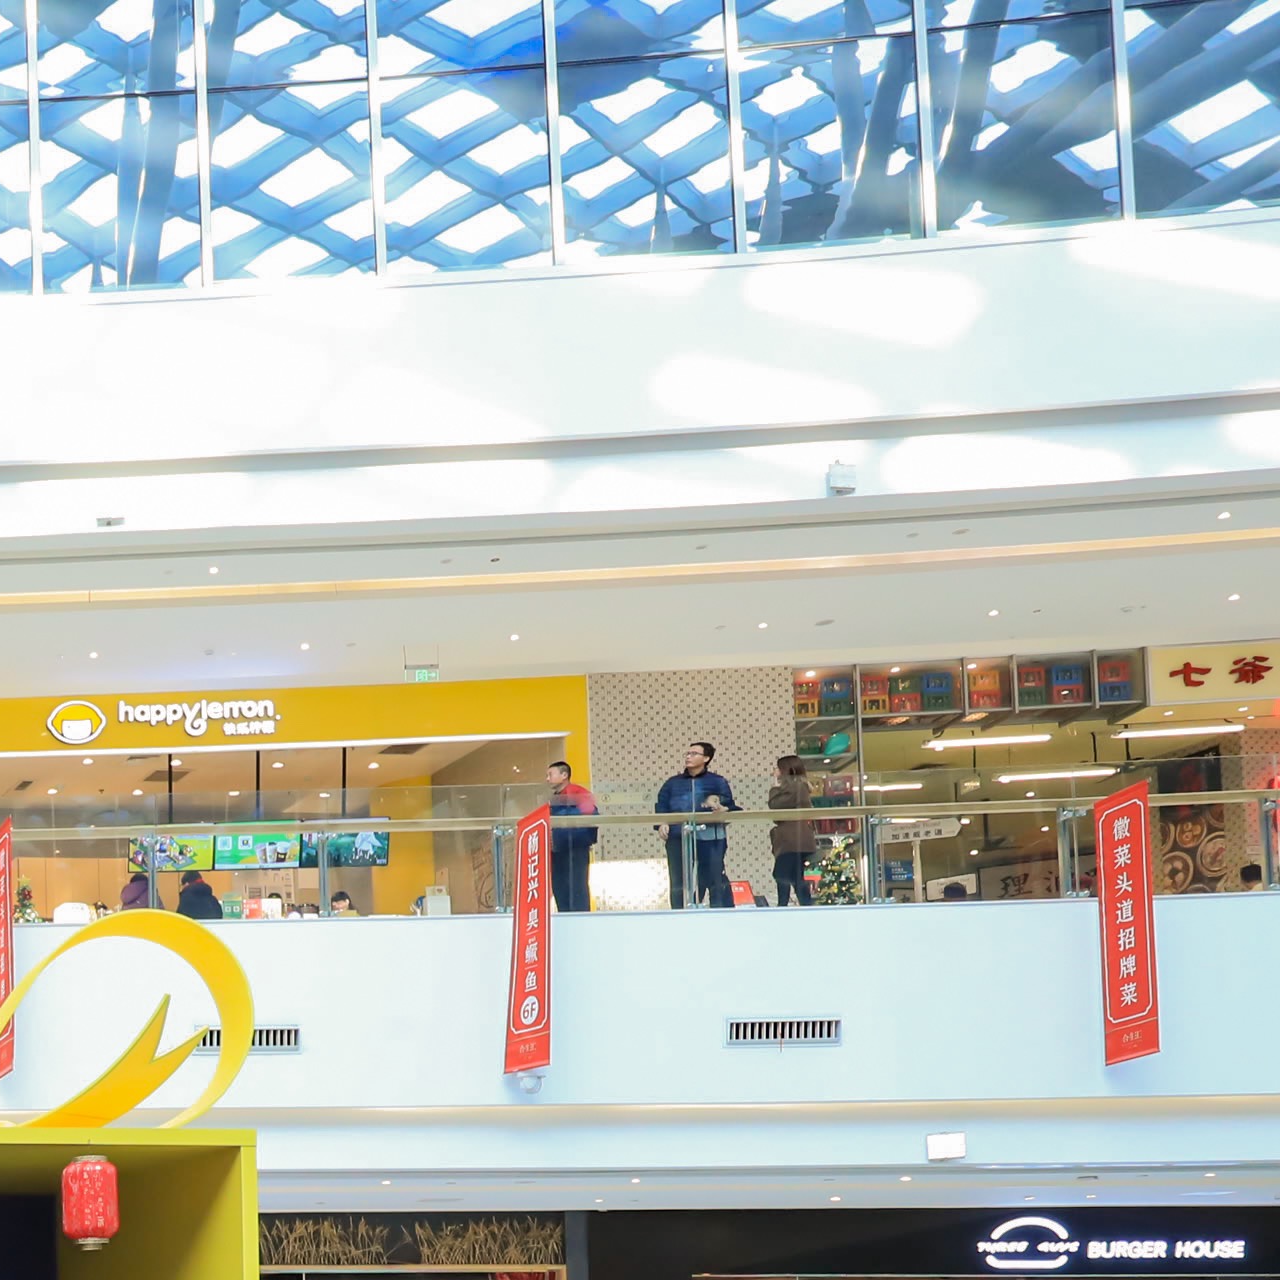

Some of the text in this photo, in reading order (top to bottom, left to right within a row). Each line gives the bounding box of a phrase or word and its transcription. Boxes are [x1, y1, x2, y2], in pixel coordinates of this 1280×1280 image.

[1113, 815, 1138, 1008] 徽菜头道招牌菜
[522, 1001, 537, 1018] 6F
[1087, 1240, 1168, 1259] BURGER
[1175, 1240, 1246, 1259] HOUSE
